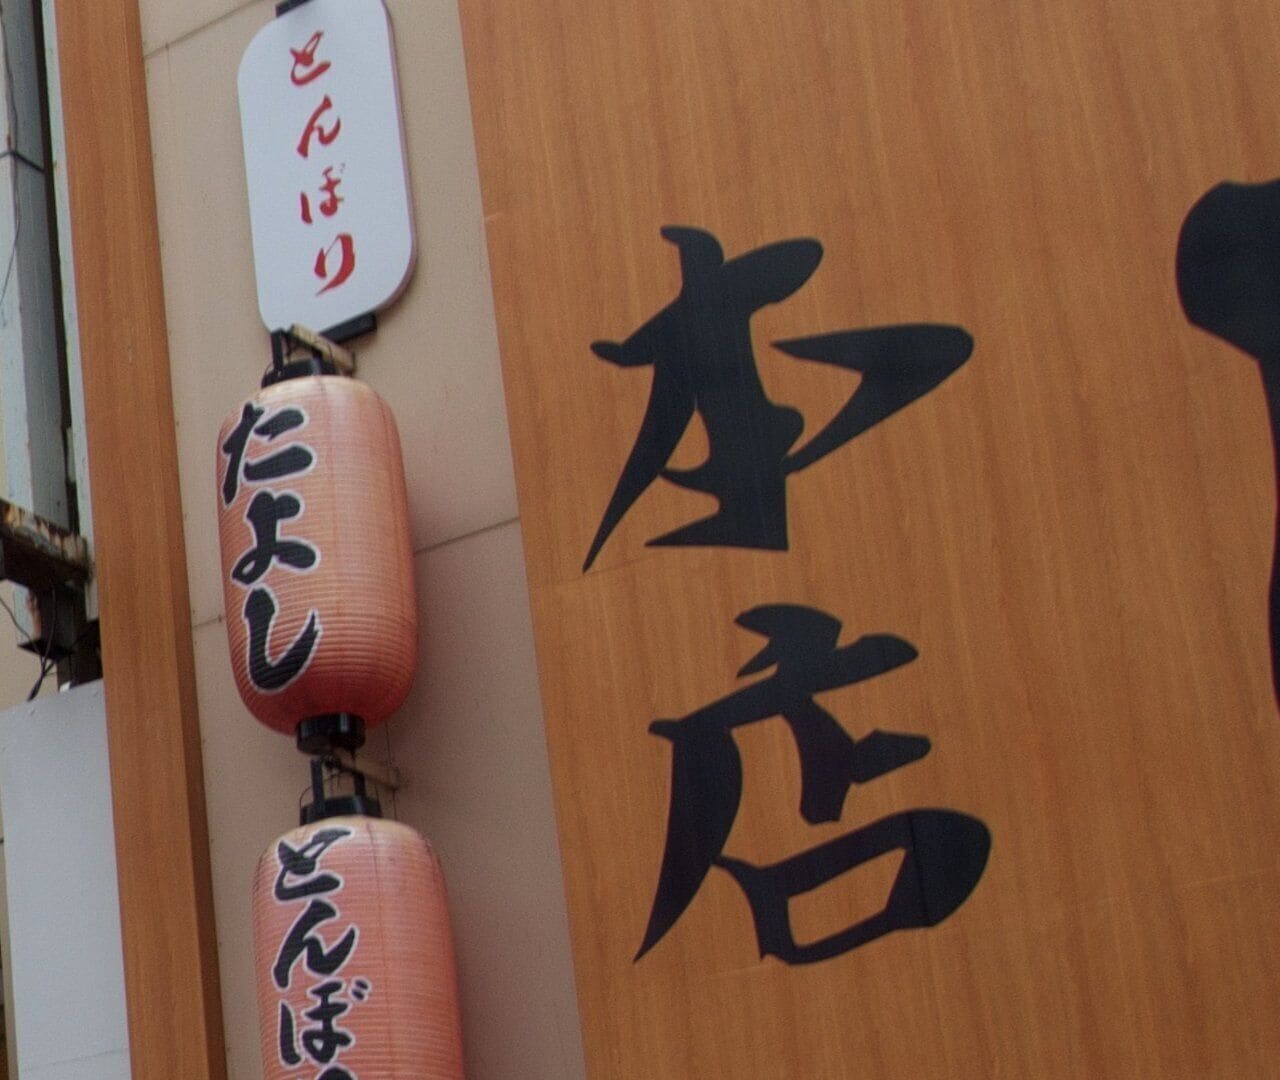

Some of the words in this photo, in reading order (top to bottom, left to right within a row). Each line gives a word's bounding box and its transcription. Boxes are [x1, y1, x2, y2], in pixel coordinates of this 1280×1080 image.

[223, 402, 320, 692] たよし
[582, 225, 993, 966] 本店
